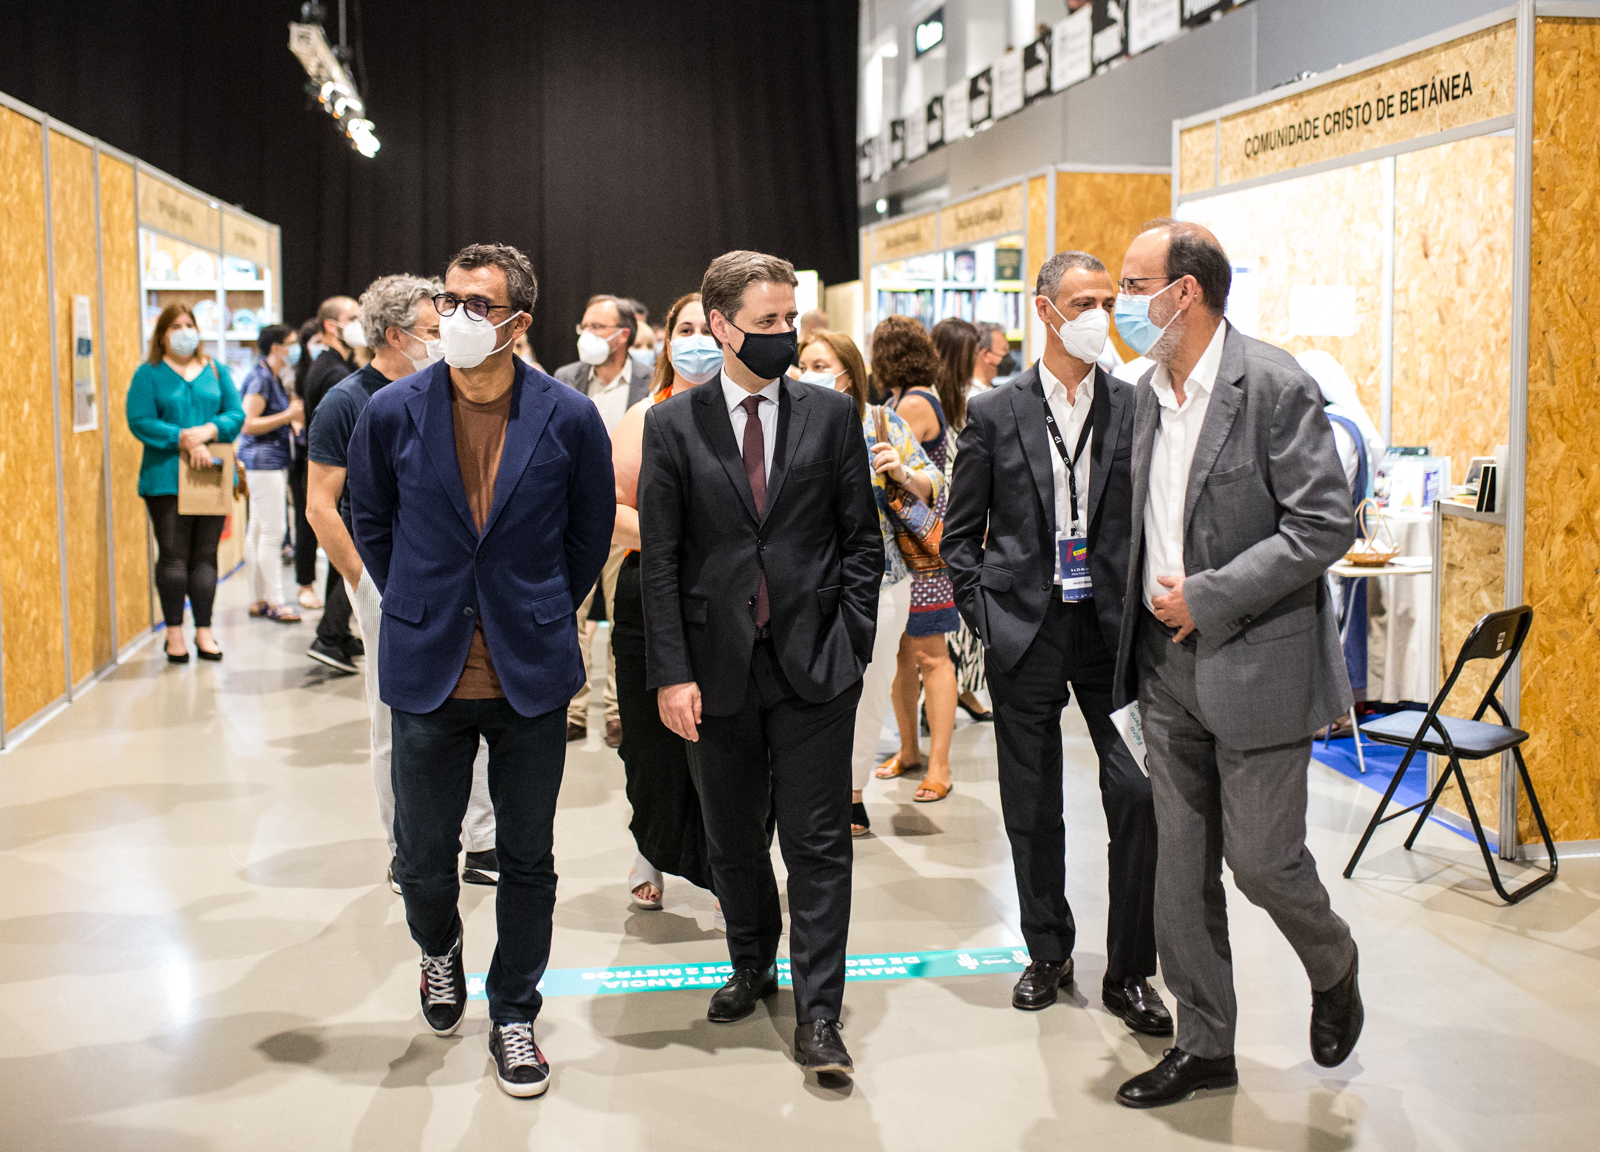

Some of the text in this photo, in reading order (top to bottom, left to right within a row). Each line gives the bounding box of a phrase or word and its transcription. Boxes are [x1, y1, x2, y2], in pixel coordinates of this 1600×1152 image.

[1245, 117, 1319, 158] COMUNIDADE
[1323, 101, 1372, 136] CRISTO
[1376, 94, 1395, 122] DE
[888, 956, 921, 965] DE
[684, 967, 700, 975] 2
[702, 965, 735, 974] DE
[581, 968, 682, 981] METROS
